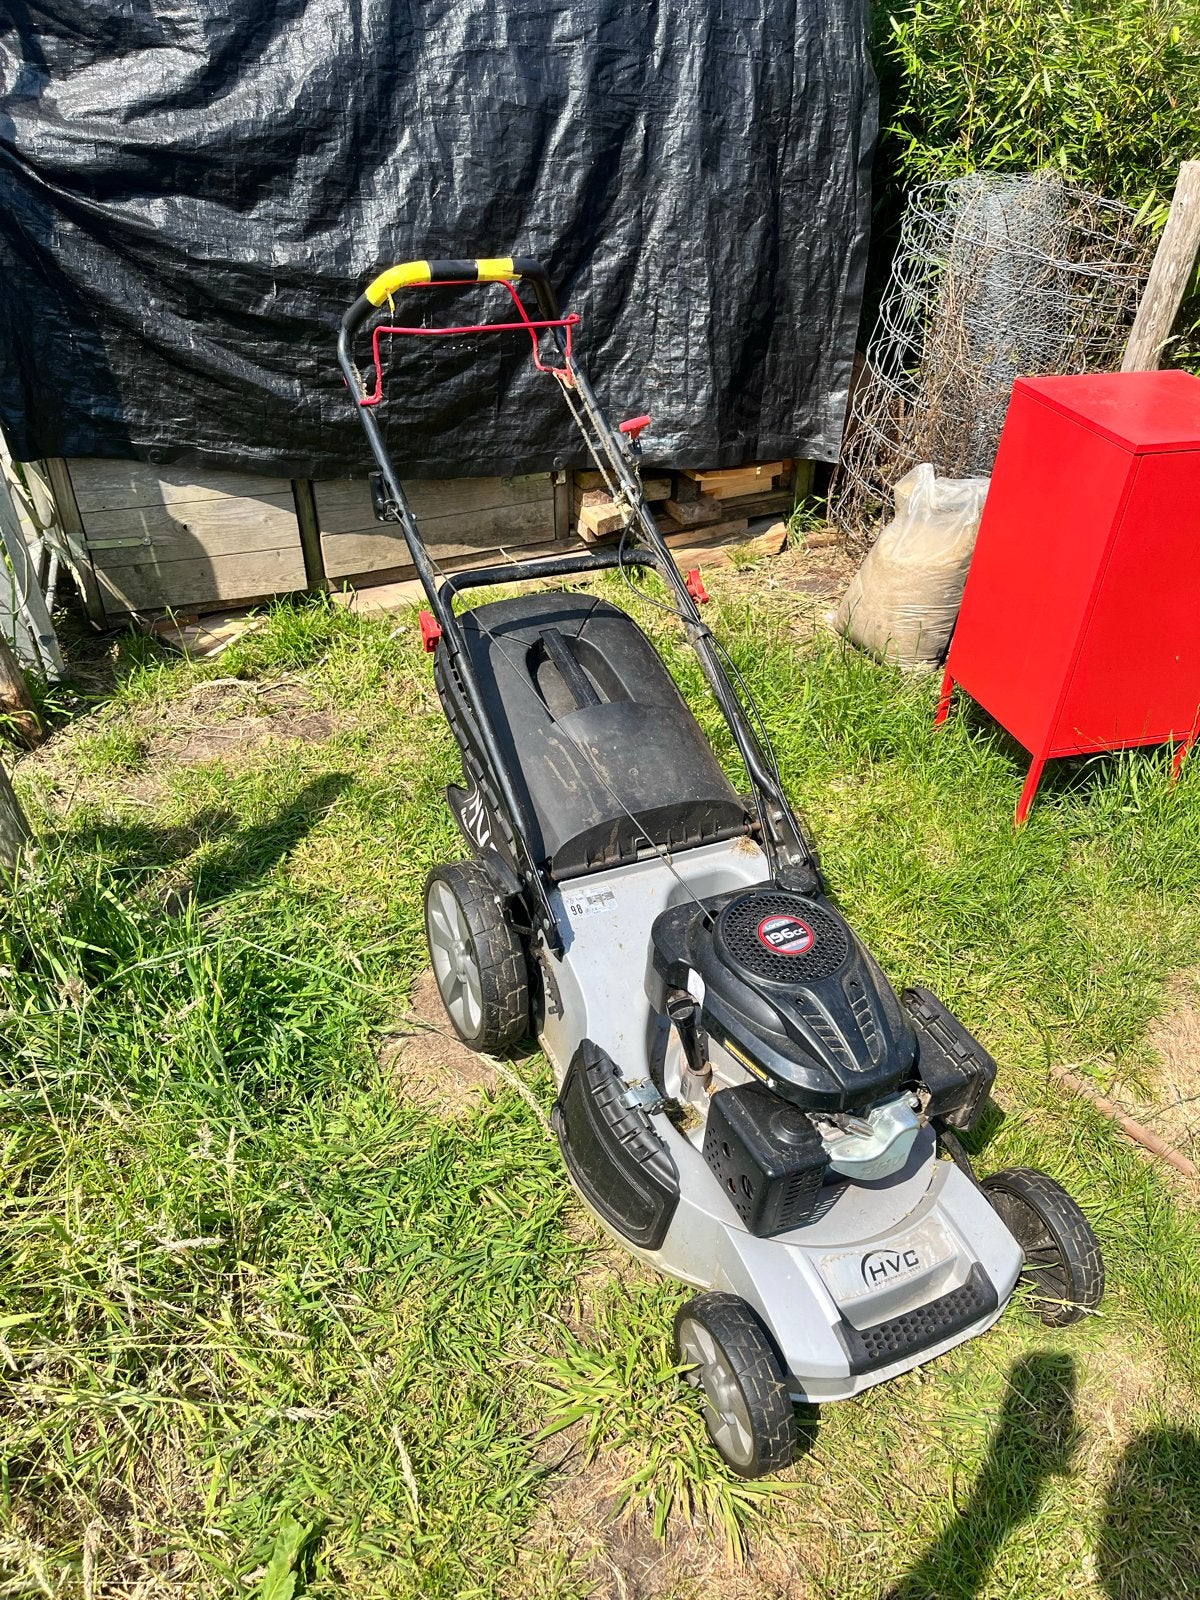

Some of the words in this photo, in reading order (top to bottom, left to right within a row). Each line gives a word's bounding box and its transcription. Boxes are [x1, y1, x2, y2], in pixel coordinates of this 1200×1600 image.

[570, 903, 583, 916] 98
[765, 927, 807, 945] 196cc
[868, 1249, 919, 1282] HVC
